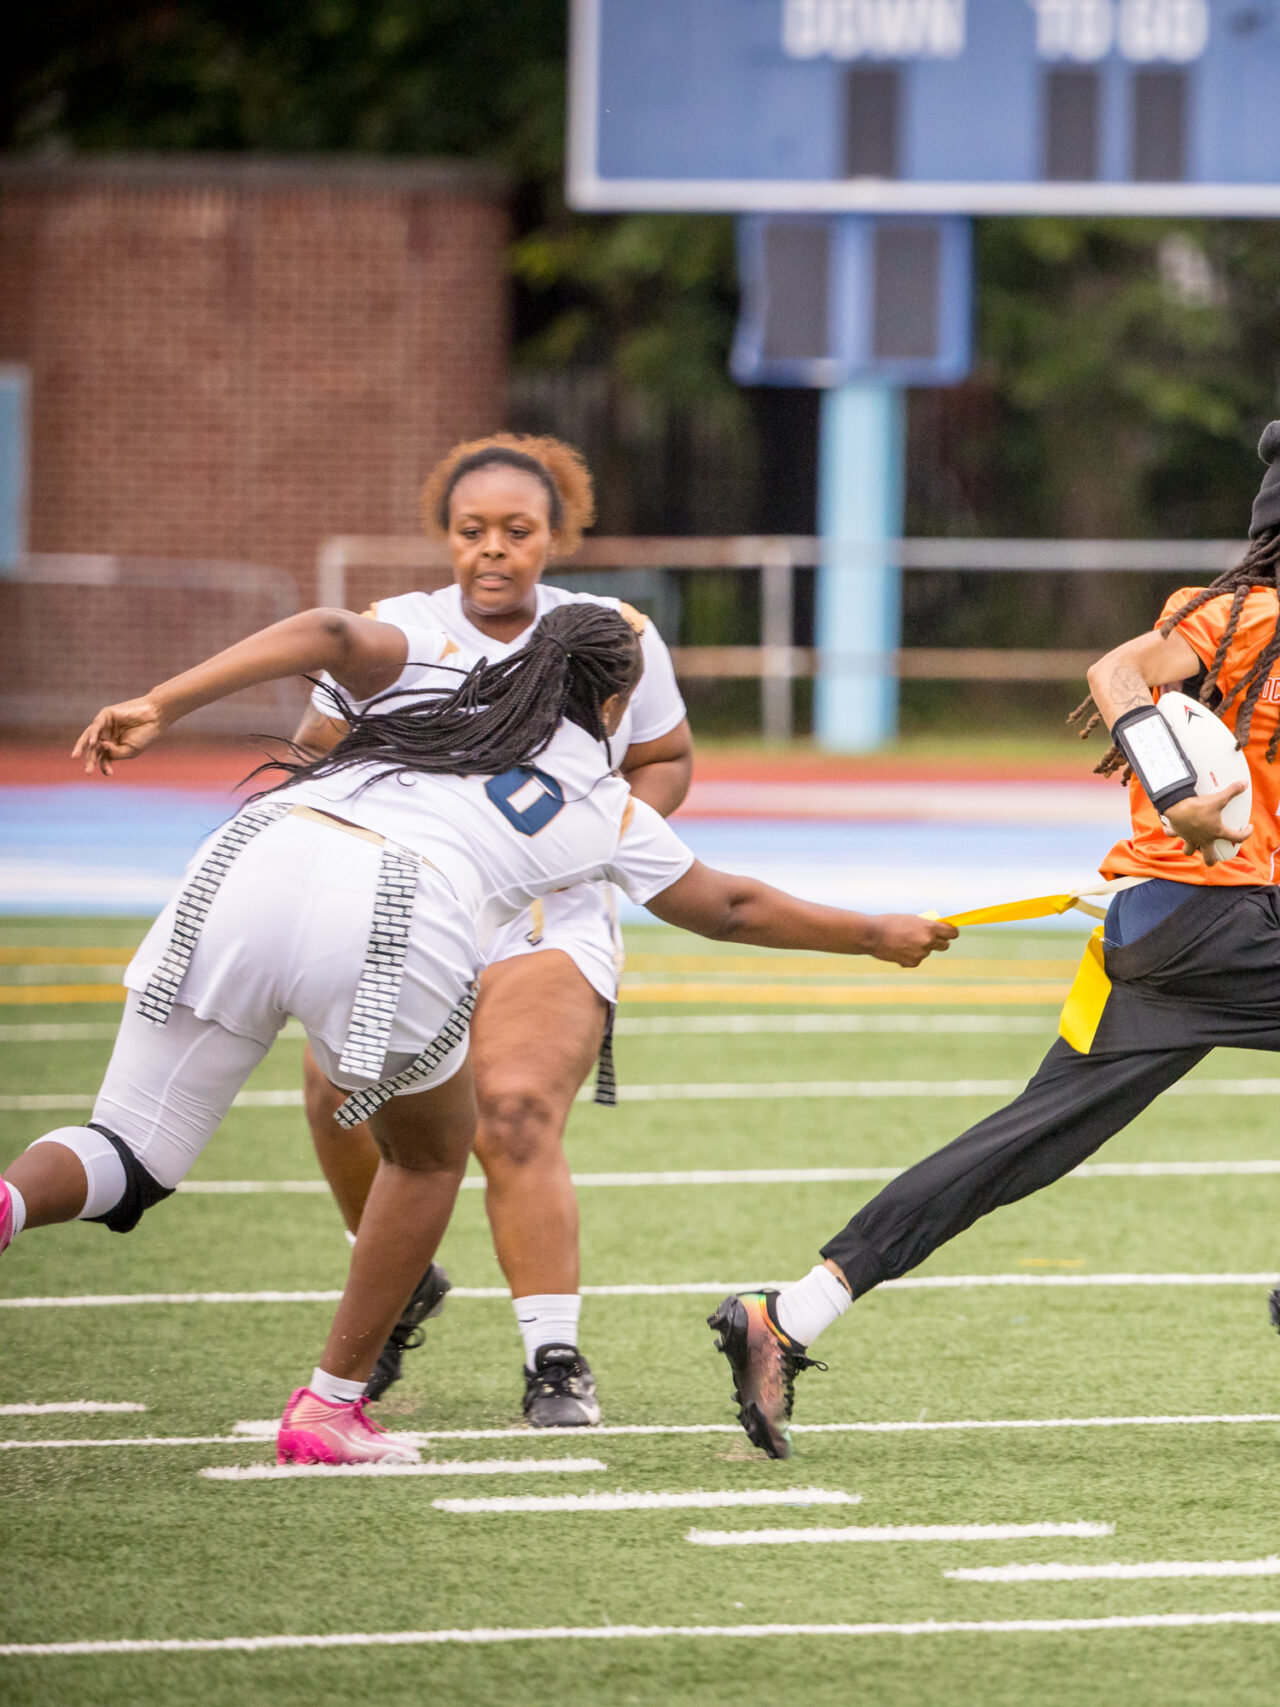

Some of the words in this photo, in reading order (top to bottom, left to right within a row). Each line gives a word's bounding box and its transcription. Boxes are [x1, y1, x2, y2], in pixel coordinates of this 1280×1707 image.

[782, 0, 964, 57] DOWN
[1033, 0, 1113, 60] TO
[1118, 0, 1209, 61] GO
